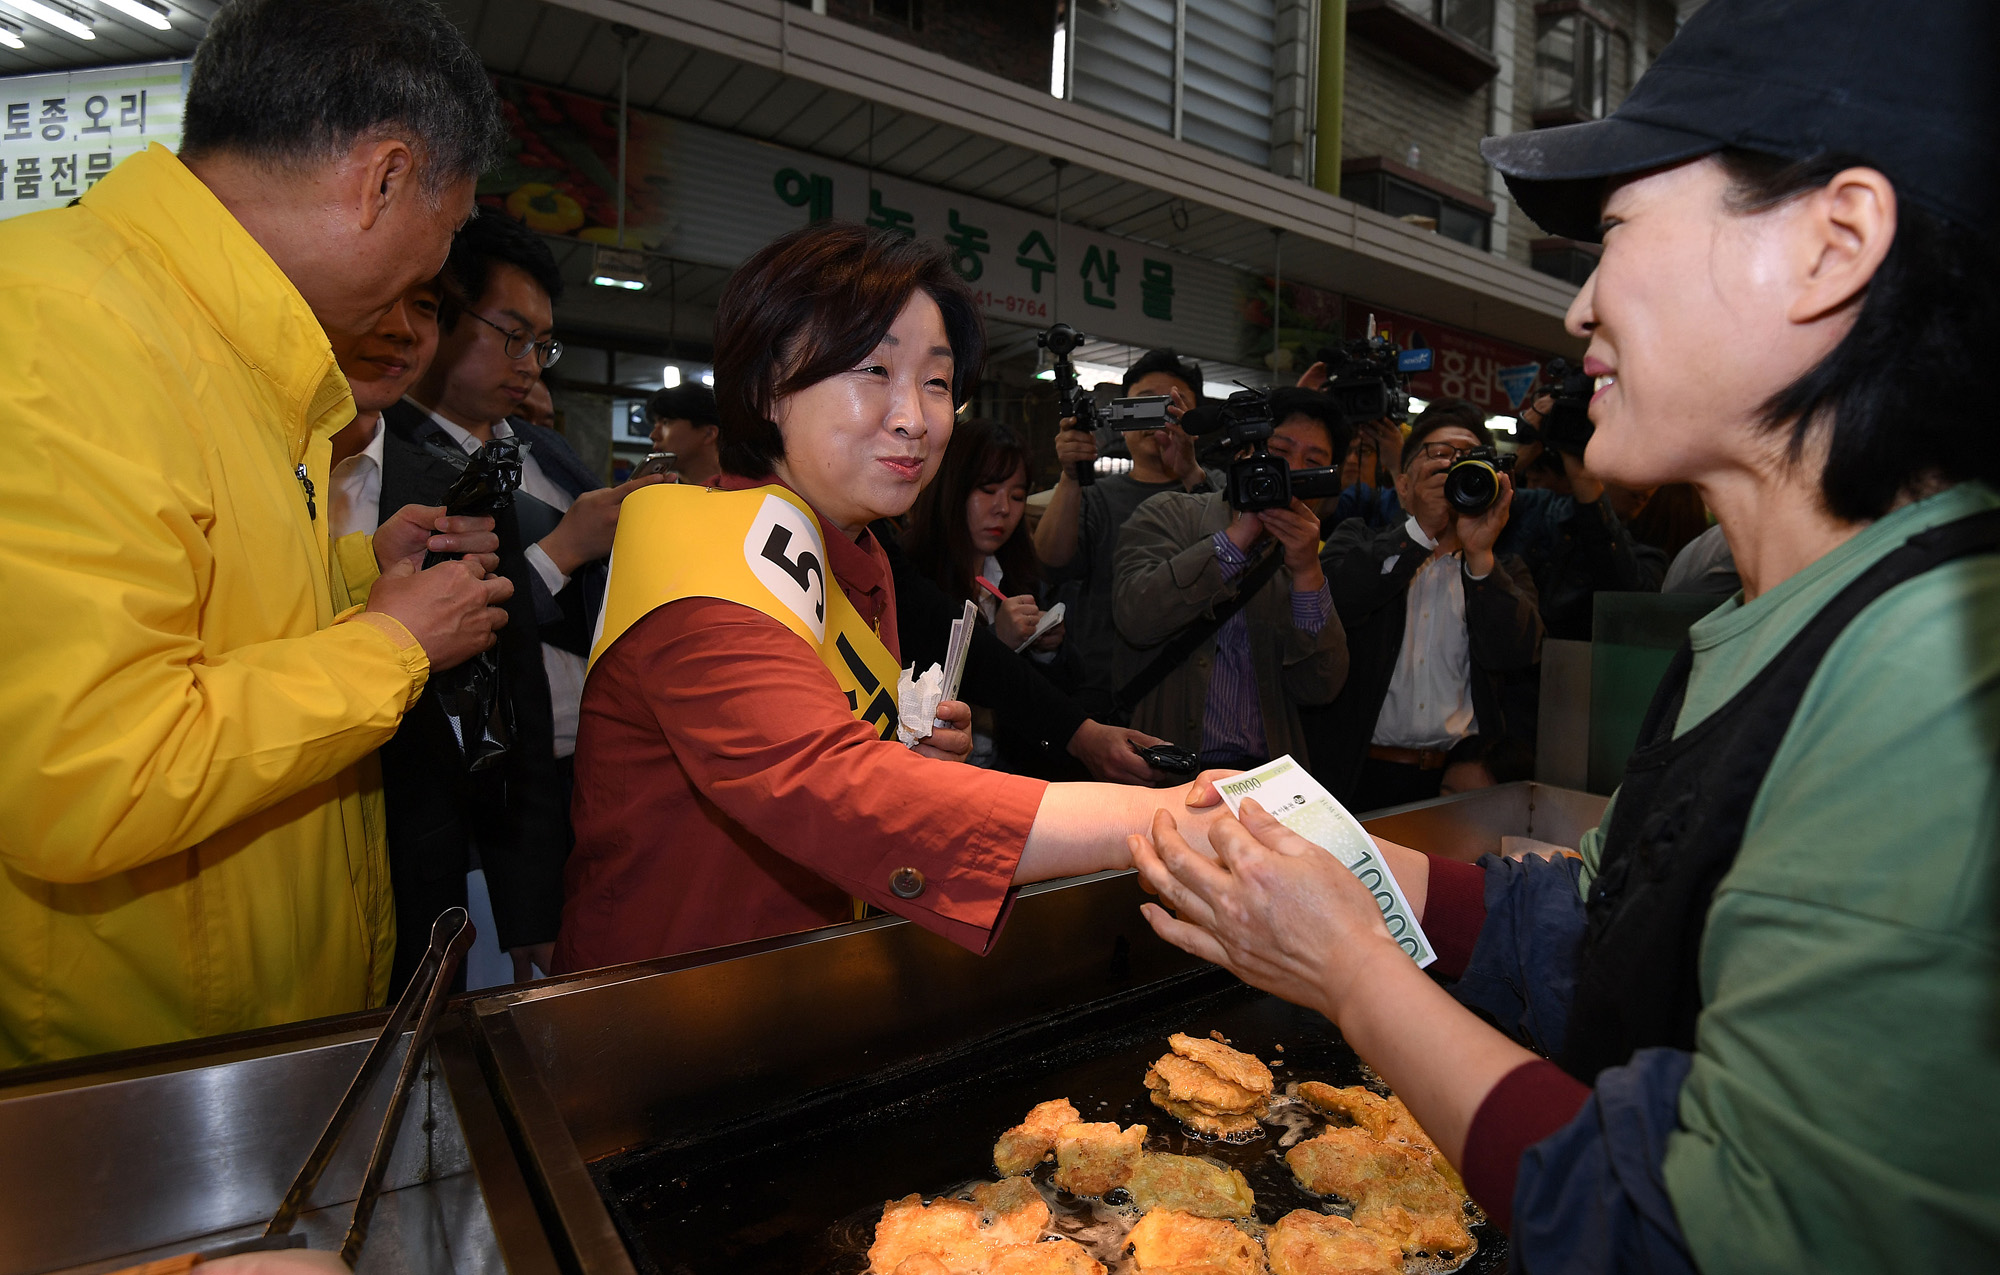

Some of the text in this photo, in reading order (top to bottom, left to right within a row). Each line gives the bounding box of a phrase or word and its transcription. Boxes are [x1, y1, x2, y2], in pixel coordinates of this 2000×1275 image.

[969, 288, 1047, 318] 41-9764
[761, 523, 824, 624] 5
[1228, 777, 1262, 797] 10000
